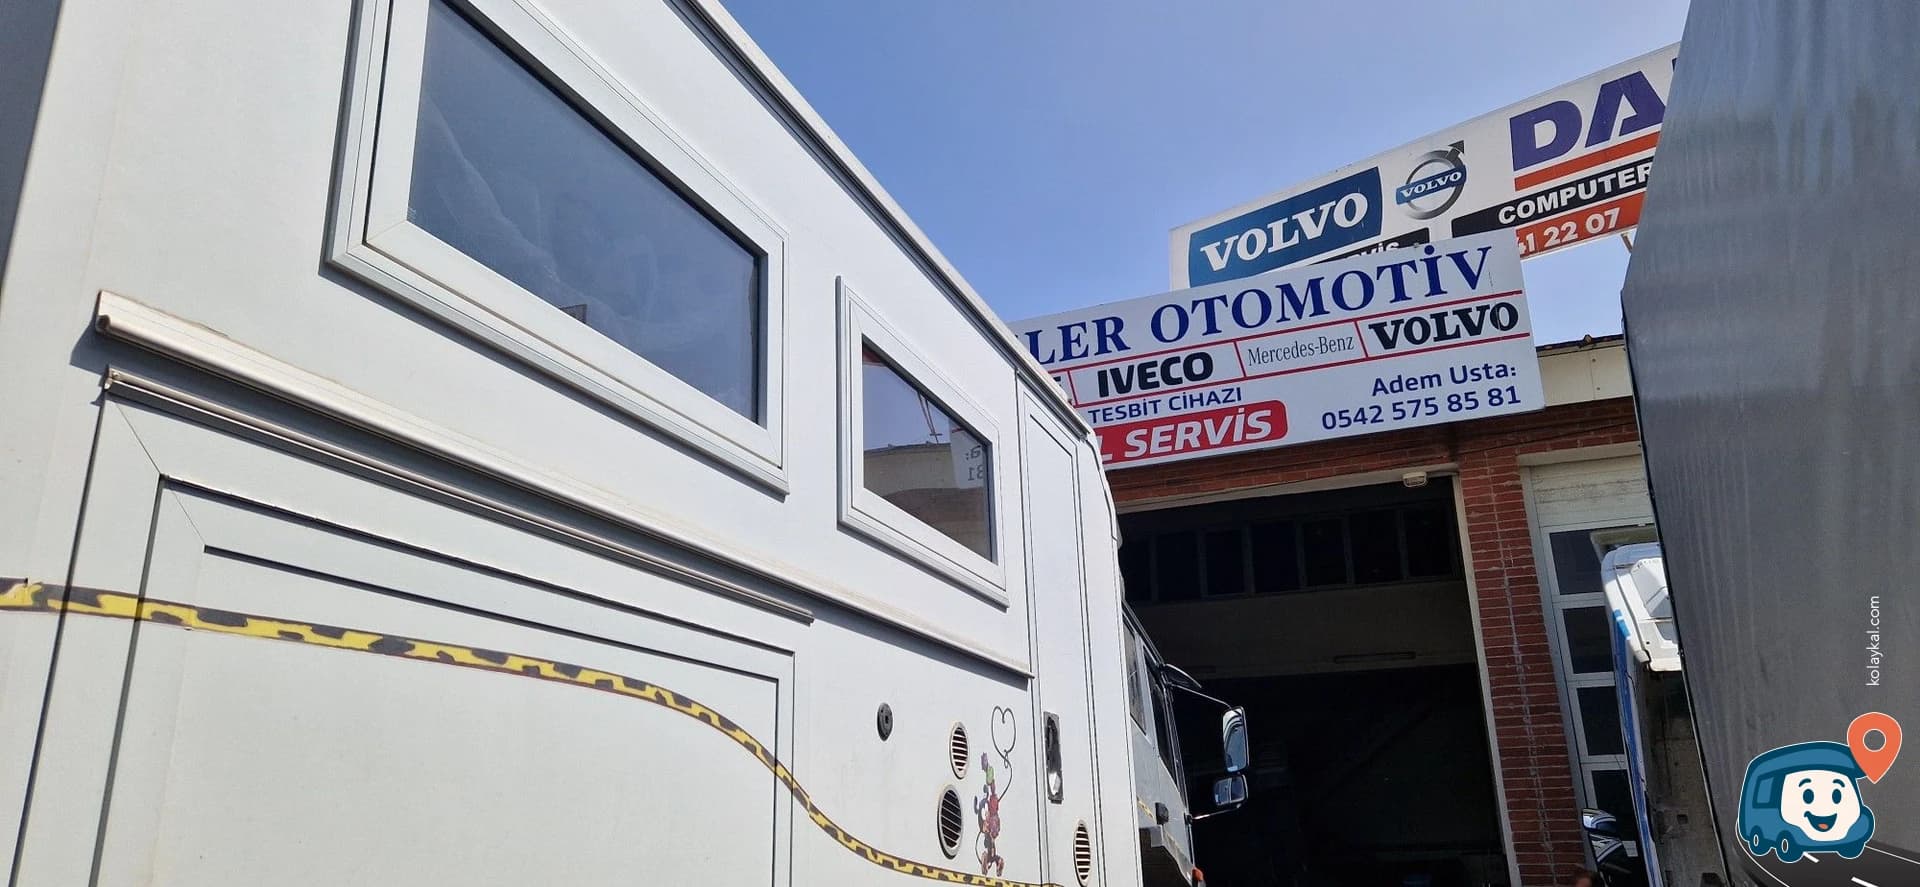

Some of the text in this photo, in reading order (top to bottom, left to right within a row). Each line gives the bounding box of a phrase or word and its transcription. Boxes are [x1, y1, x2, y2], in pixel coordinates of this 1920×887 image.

[1509, 57, 1677, 172] DA
[1400, 171, 1462, 198] VOLVO
[1498, 162, 1651, 225] COMPUTER
[1200, 192, 1368, 272] VOLVO
[1543, 221, 1579, 248] 22
[1585, 208, 1620, 235] 07
[1151, 245, 1491, 343] OTOMOTİV
[1369, 301, 1519, 350] VOLVO
[1098, 351, 1214, 398] IVECO
[1248, 335, 1354, 367] Mercedes-Benz
[1372, 363, 1517, 397] Adem Usta:
[1088, 386, 1242, 424] TESBİT CİHAZI
[1322, 385, 1521, 430] 0542 575 85 81
[1124, 407, 1272, 458] SERVİS
